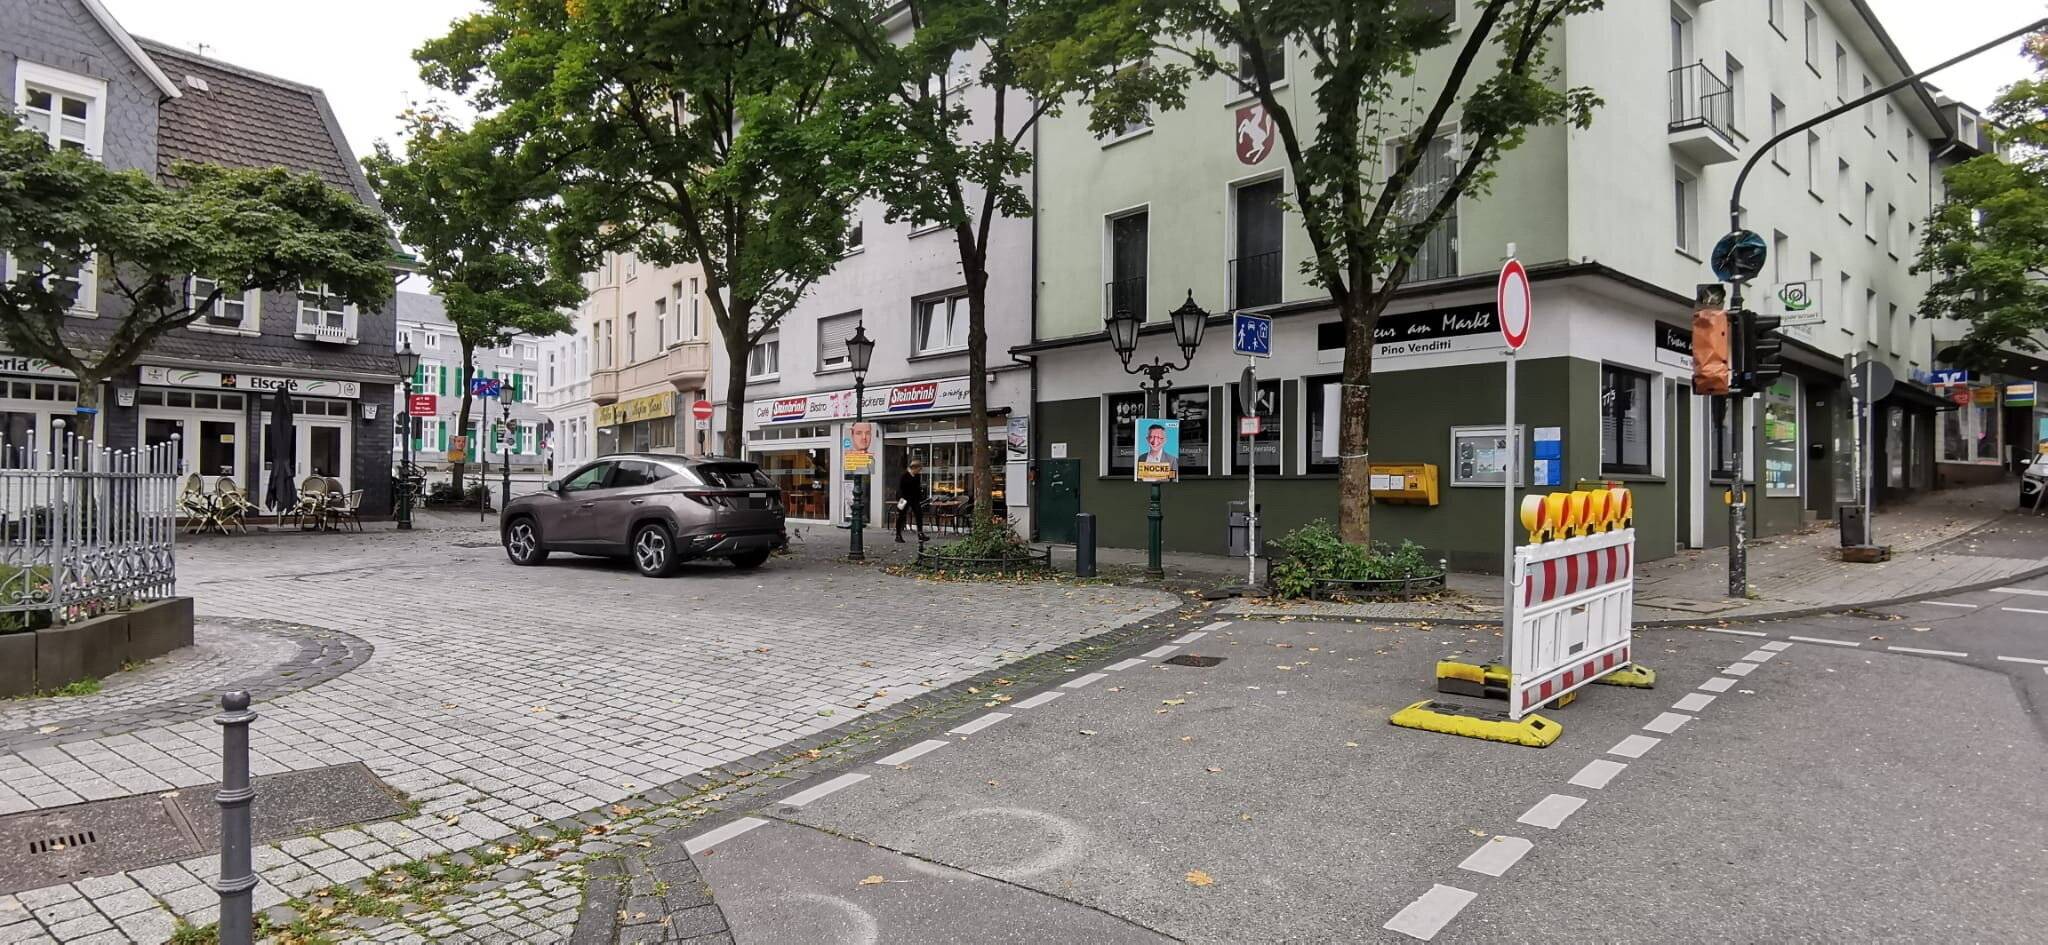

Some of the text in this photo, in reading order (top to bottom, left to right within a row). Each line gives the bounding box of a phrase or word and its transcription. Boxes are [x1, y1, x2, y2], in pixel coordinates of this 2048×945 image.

[1407, 323, 1432, 335] am
[1442, 311, 1491, 332] Markt
[1381, 340, 1452, 355] Pino Venditti
[0, 357, 29, 372] ria
[250, 377, 299, 391] Eiscafé
[756, 406, 770, 418] Café
[773, 398, 806, 416] Steinbrink
[809, 401, 828, 412] Bistro
[890, 384, 936, 405] Steinbrink
[1143, 465, 1169, 473] NOCKE
